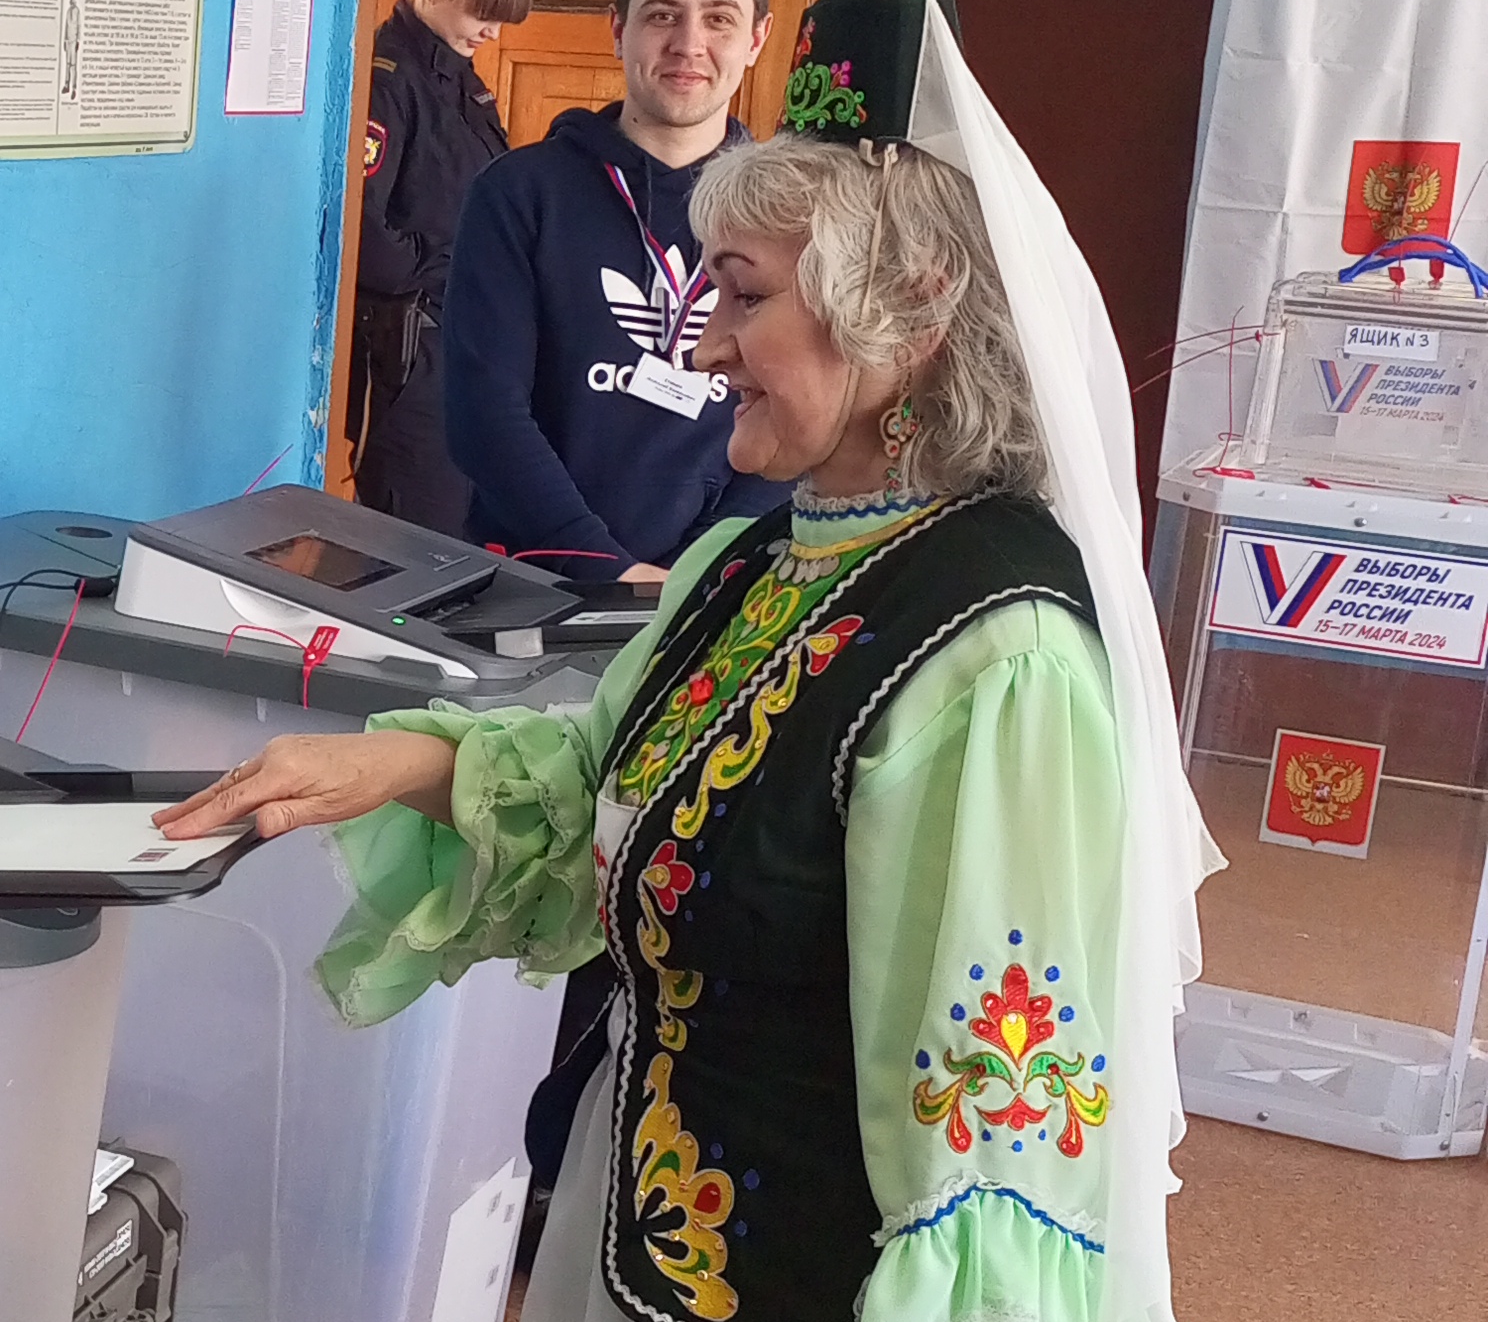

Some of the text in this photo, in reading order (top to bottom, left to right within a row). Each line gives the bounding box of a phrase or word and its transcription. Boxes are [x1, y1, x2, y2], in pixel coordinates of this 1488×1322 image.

[1348, 327, 1402, 348] ЯЩИК
[1420, 334, 1429, 347] 3
[1384, 365, 1446, 380] ВЫБОРЫ
[1376, 379, 1460, 396] ПРЕЗИДЕНТА
[1367, 393, 1422, 407] РОССИИ
[1387, 409, 1419, 421] МАРТА
[1354, 558, 1451, 584] ВЫБОРЫ
[1339, 579, 1474, 611] ПРЕЗИДЕНТА
[1324, 599, 1413, 625] РОССИИ
[1360, 625, 1409, 645] МАРТА
[1411, 632, 1448, 650] 2024
